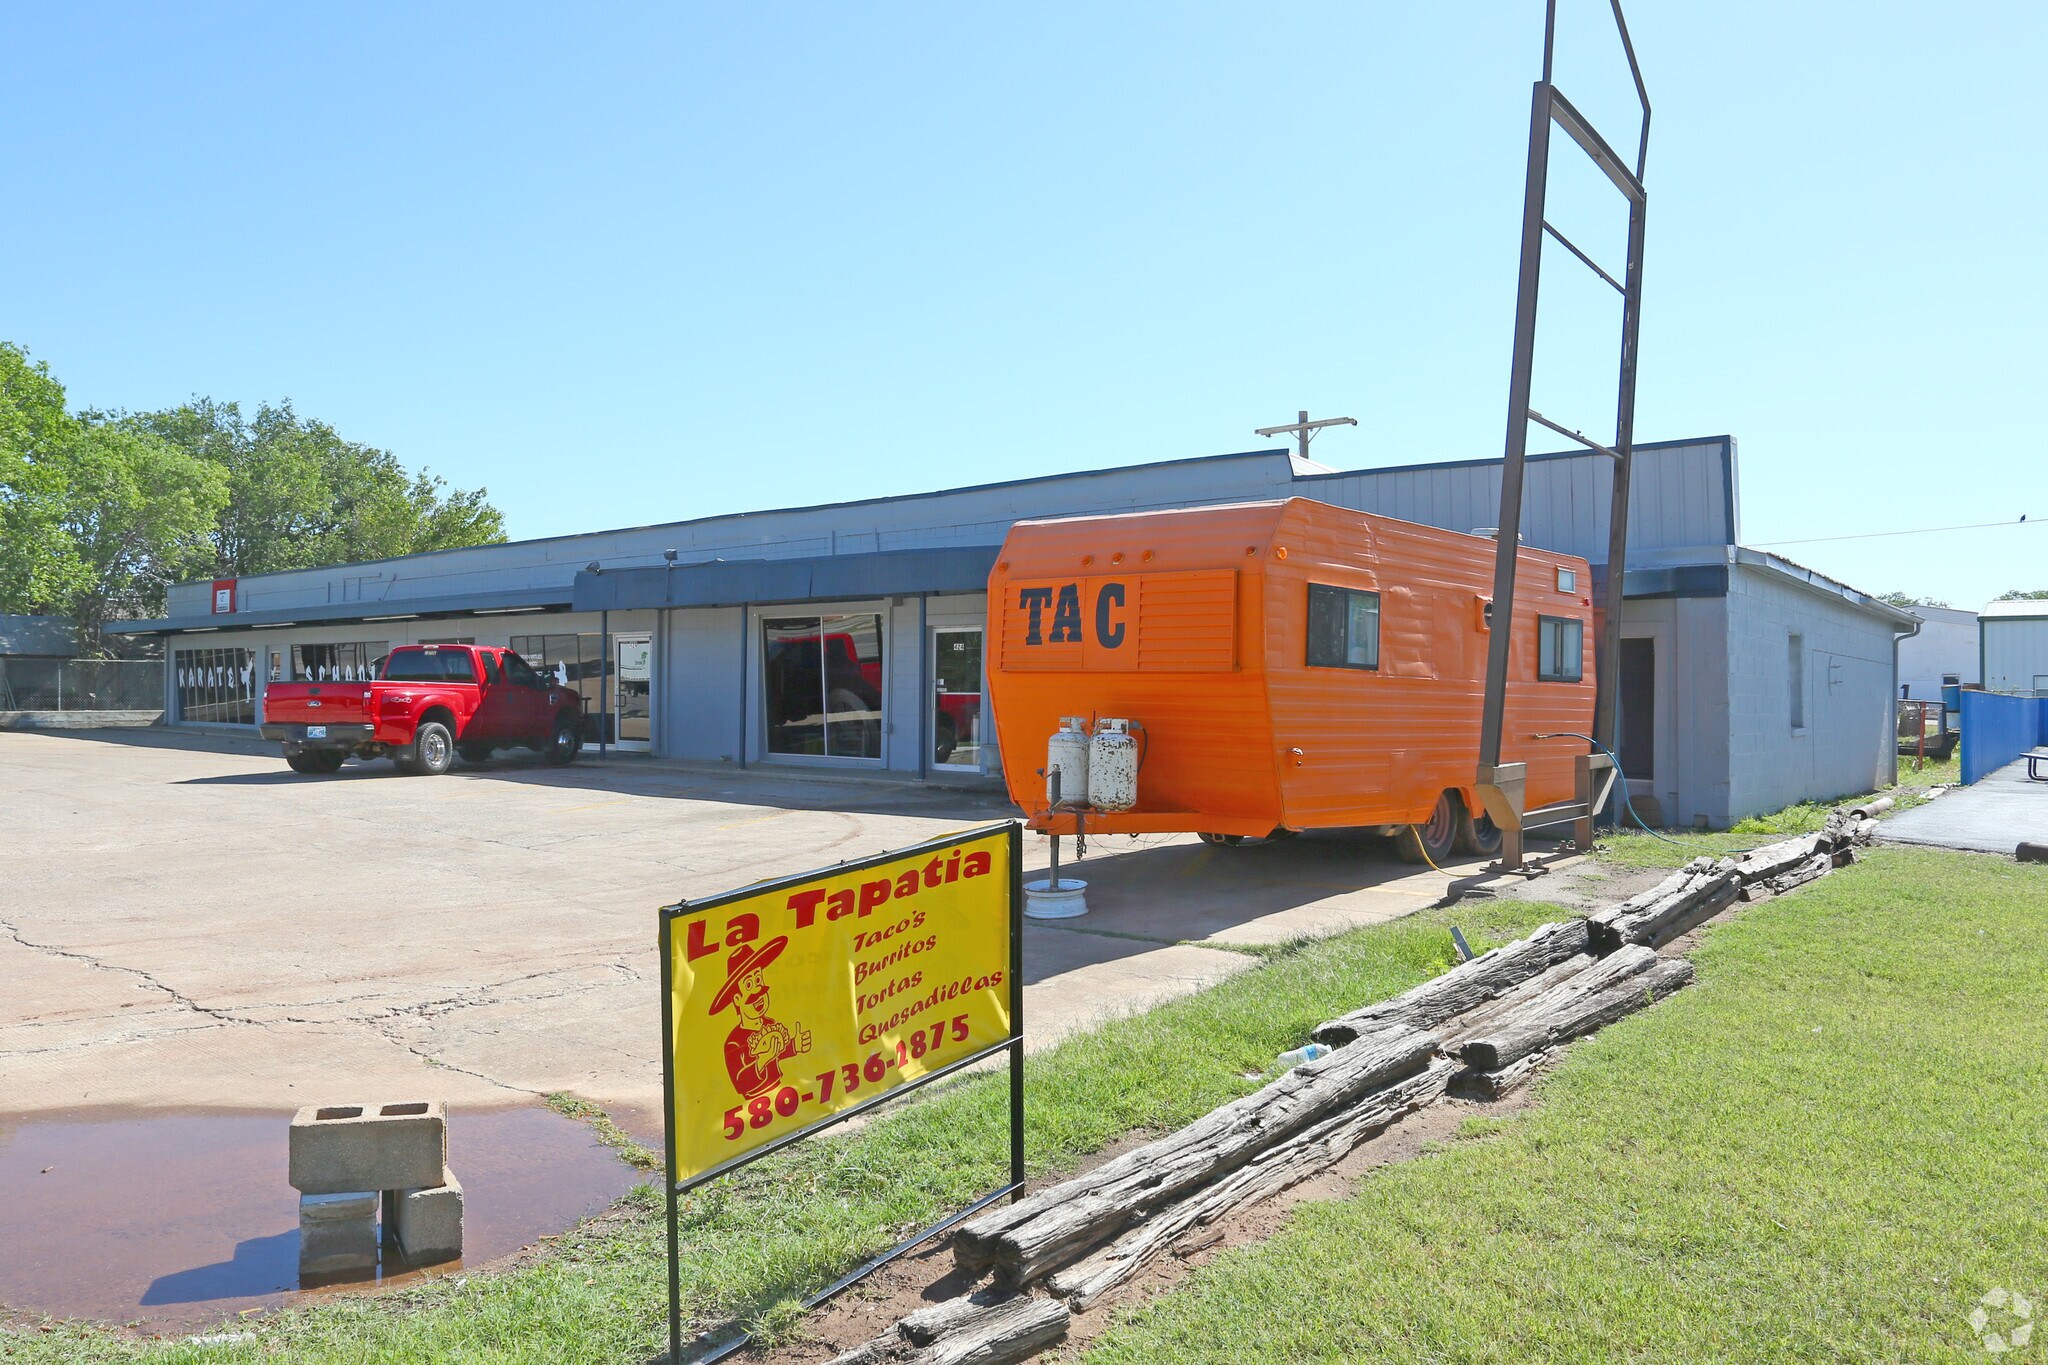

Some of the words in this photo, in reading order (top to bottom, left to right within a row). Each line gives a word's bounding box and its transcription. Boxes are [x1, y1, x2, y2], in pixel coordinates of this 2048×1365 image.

[1019, 583, 1125, 649] TAC
[178, 666, 235, 689] KARATE
[687, 912, 760, 963] La
[787, 849, 992, 930] Tapatia
[853, 909, 927, 953] Taco's
[854, 934, 937, 986] Burritos
[856, 970, 924, 1017] Tortas
[858, 970, 1003, 1046] Quesadillas
[723, 1013, 970, 1141] 580-736-2875
